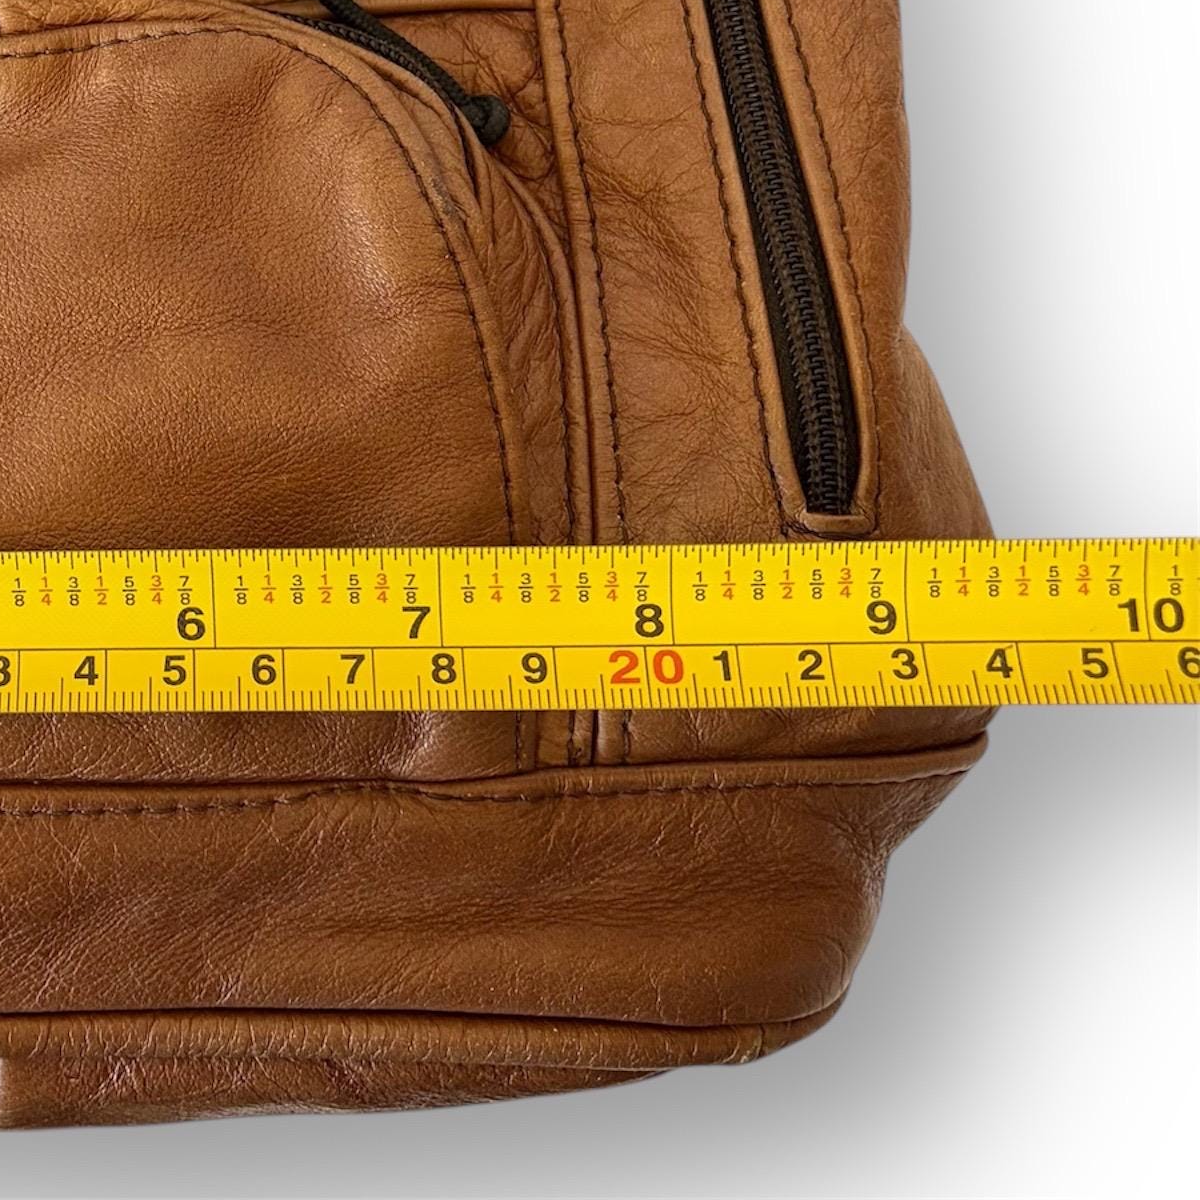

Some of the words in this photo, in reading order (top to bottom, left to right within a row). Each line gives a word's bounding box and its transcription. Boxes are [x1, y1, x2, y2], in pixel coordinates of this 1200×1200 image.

[176, 607, 206, 640] 6
[402, 606, 430, 639] 7
[634, 604, 664, 638] 8
[866, 600, 896, 634] 9
[1118, 598, 1184, 633] 10
[74, 656, 98, 686] 4
[162, 656, 186, 686] 5
[251, 654, 276, 686] 6
[340, 654, 366, 684] 7
[431, 652, 457, 684] 8
[520, 652, 548, 684] 9
[608, 649, 684, 685] 20
[712, 650, 732, 682] 1
[798, 650, 824, 680] 2
[890, 648, 918, 680] 3
[986, 648, 1013, 678] 4
[1080, 648, 1108, 679] 5
[1178, 646, 1200, 678] 6
